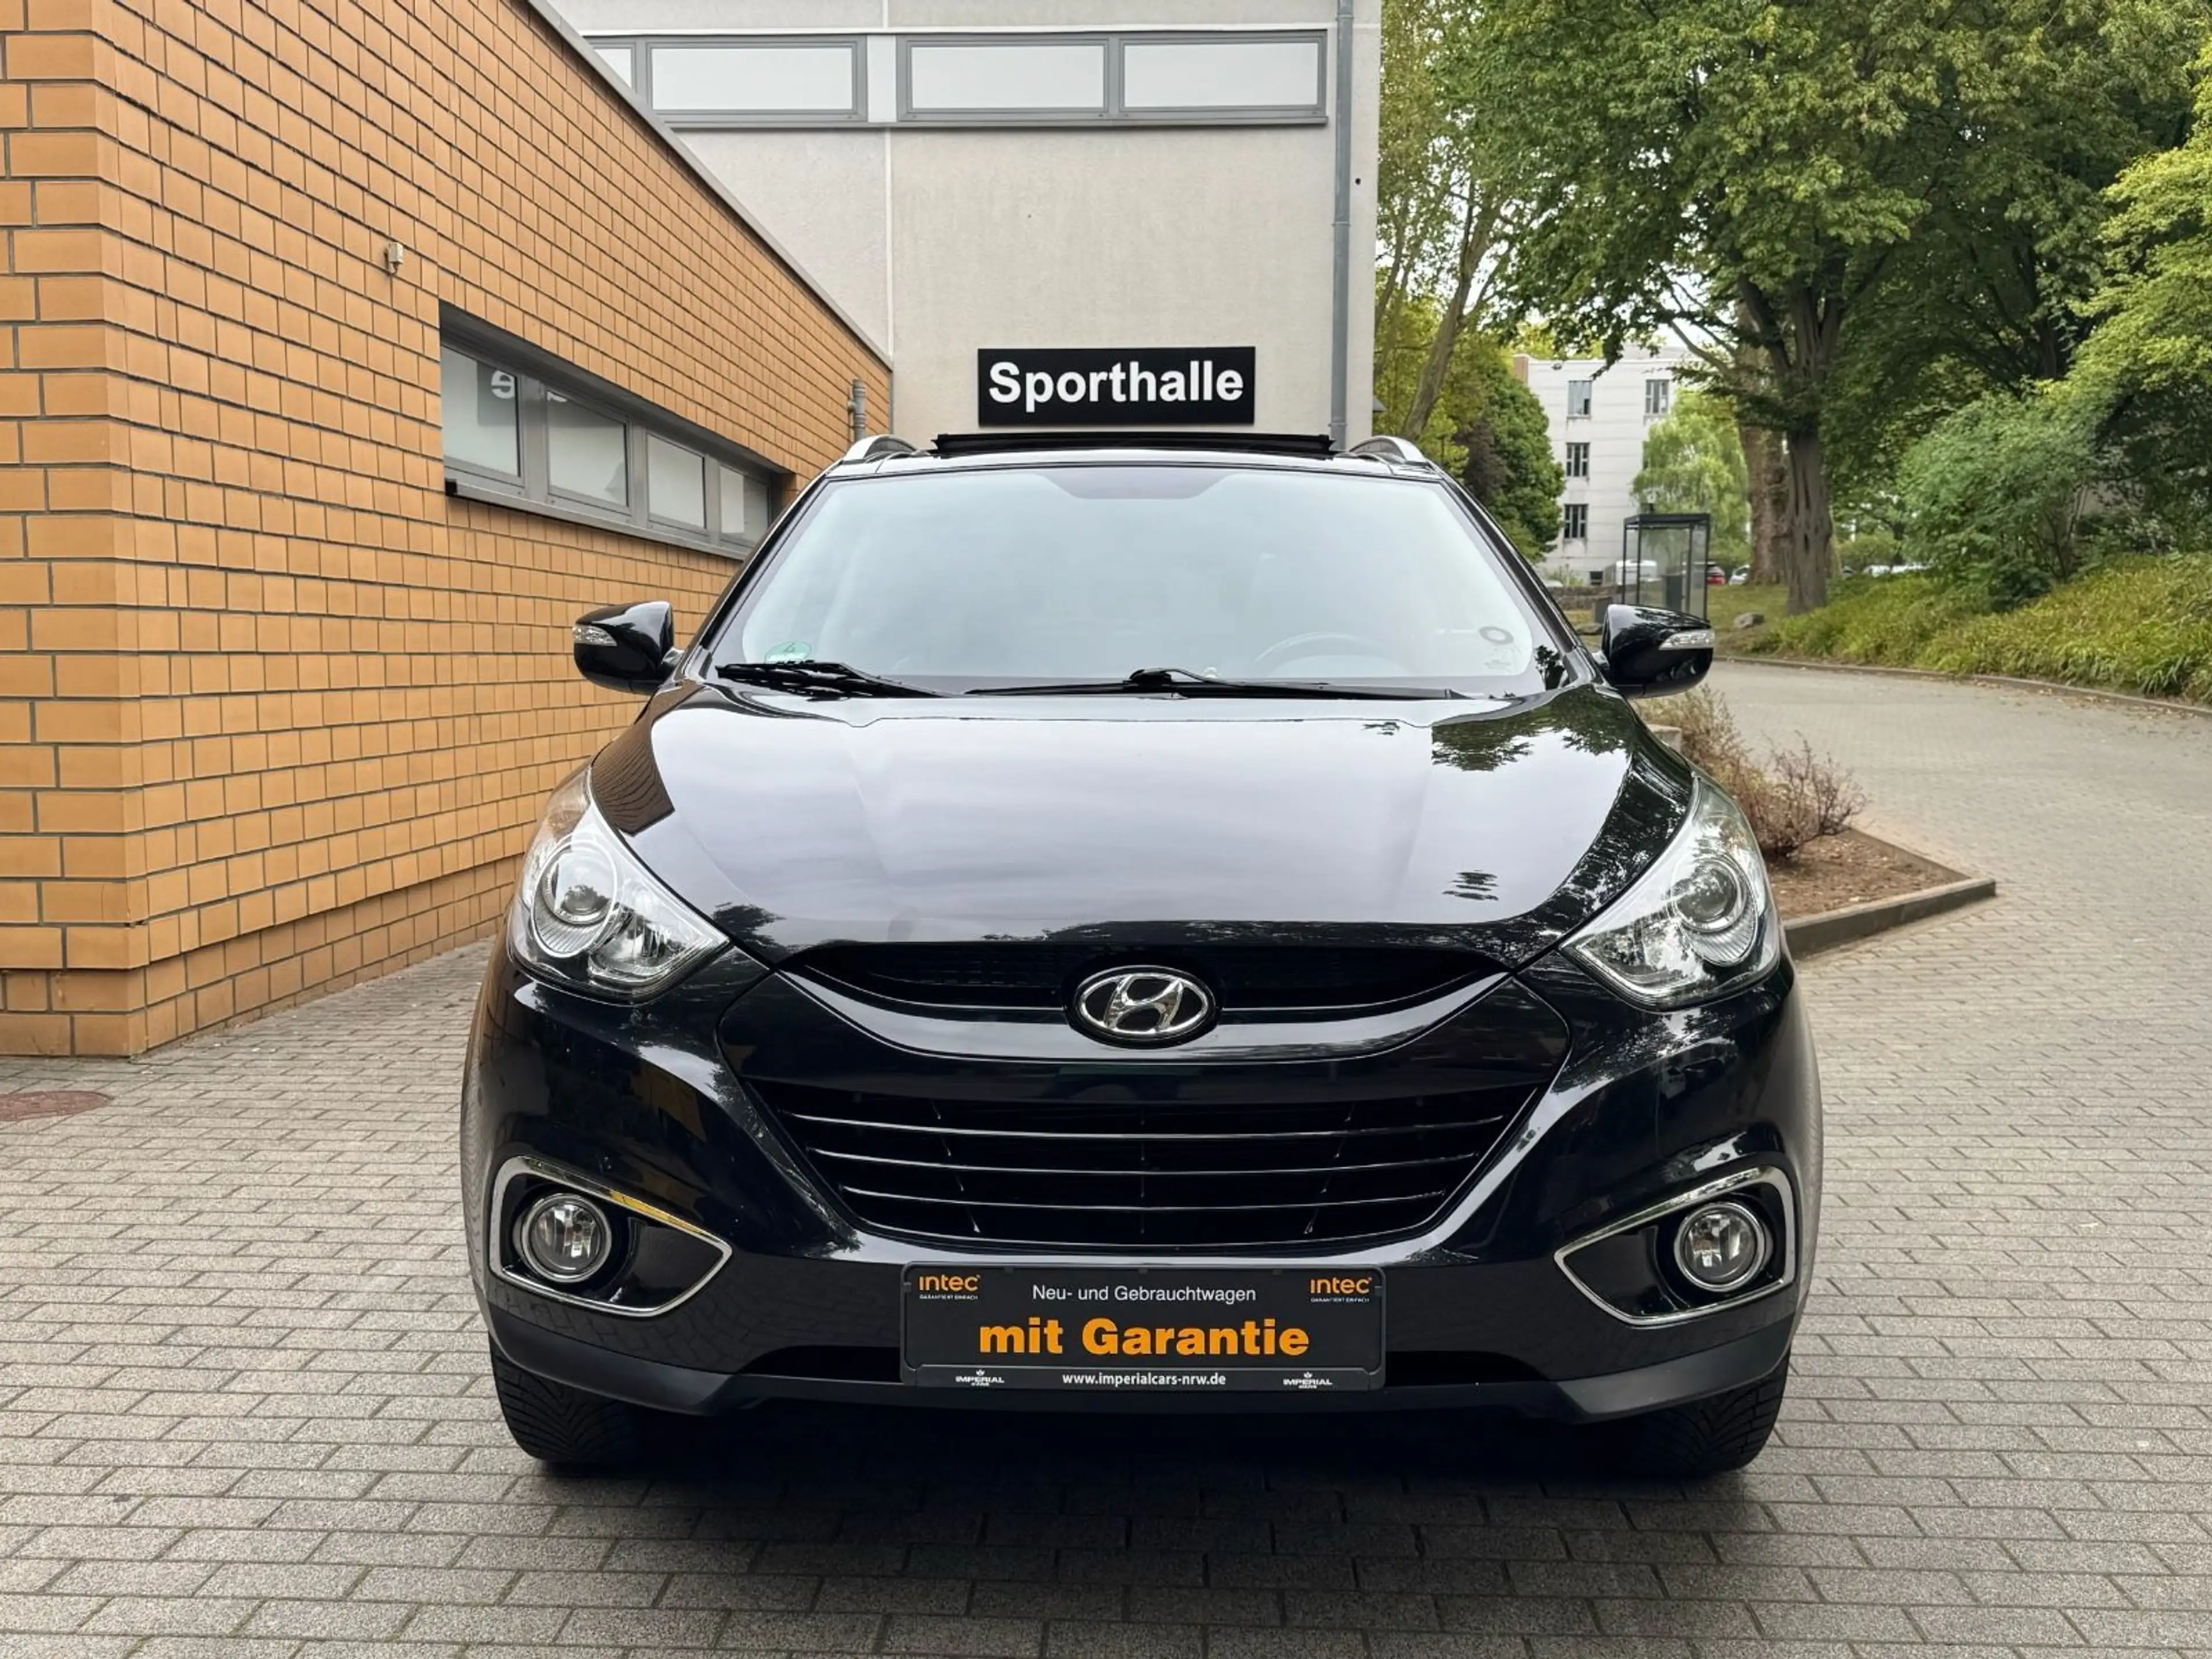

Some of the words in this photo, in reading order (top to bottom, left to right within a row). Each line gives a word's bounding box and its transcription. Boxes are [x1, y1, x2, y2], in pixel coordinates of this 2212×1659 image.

[989, 361, 1244, 412] Sporthalle
[919, 1274, 979, 1291] intec
[1310, 1277, 1371, 1294] intec
[1033, 1285, 1072, 1300] Neu-
[1078, 1286, 1108, 1300] und
[1114, 1286, 1256, 1305] Gebrauchtwagen
[979, 1317, 1063, 1354] mit
[1082, 1317, 1309, 1355] Garantie
[1062, 1372, 1226, 1386] www.imperialcars-nrw.de
